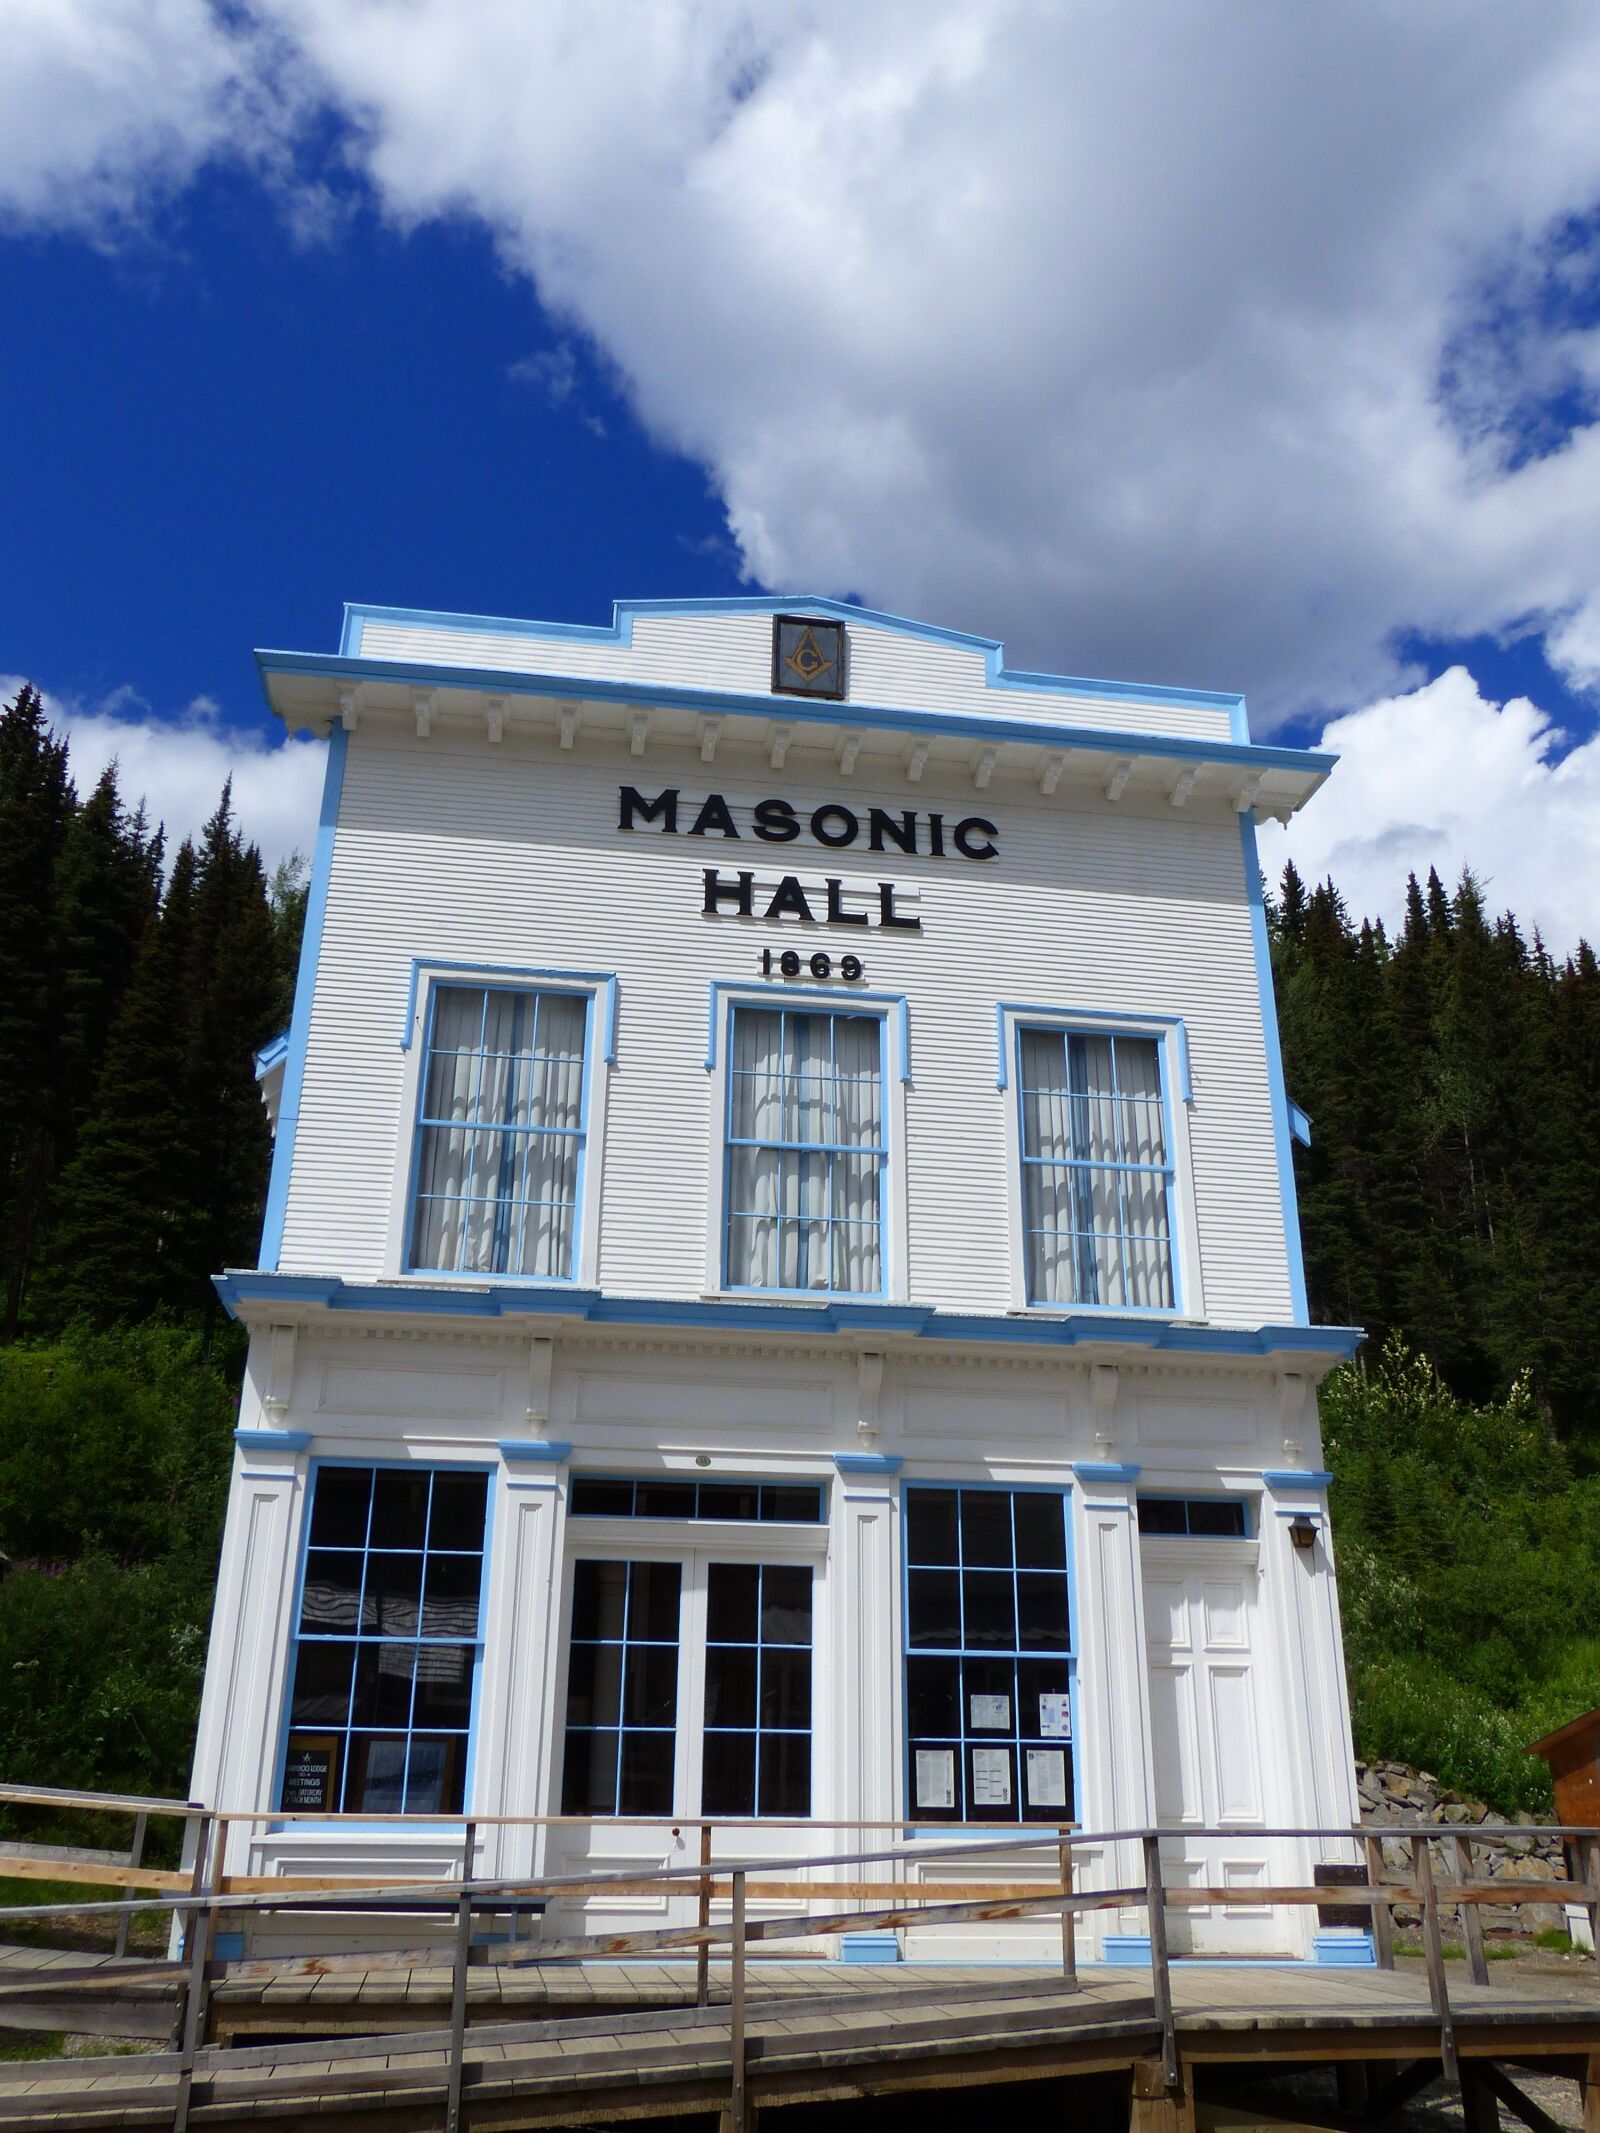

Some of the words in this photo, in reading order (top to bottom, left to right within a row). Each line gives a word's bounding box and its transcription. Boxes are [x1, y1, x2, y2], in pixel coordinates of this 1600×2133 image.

[796, 648, 818, 671] G
[616, 785, 1000, 861] MASONIC
[701, 868, 922, 930] HALL
[762, 948, 863, 983] 1869
[289, 1779, 321, 1787] MEETINGS
